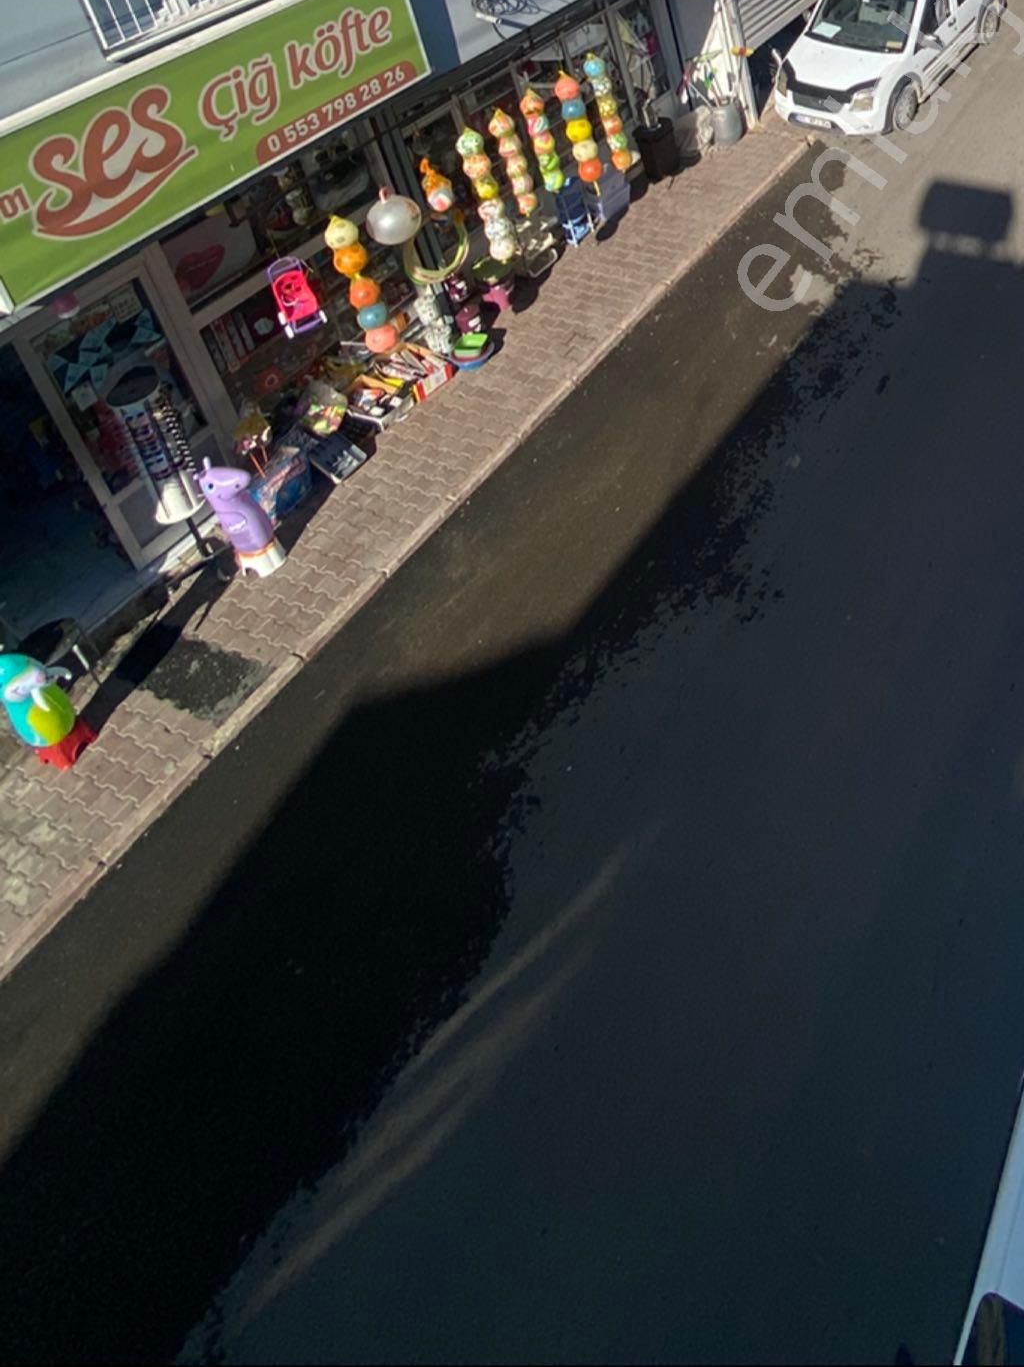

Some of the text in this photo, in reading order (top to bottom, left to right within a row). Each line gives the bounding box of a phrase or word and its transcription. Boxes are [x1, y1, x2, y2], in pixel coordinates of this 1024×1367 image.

[287, 9, 390, 87] köfte
[267, 66, 405, 152] 0 553 798 28 26
